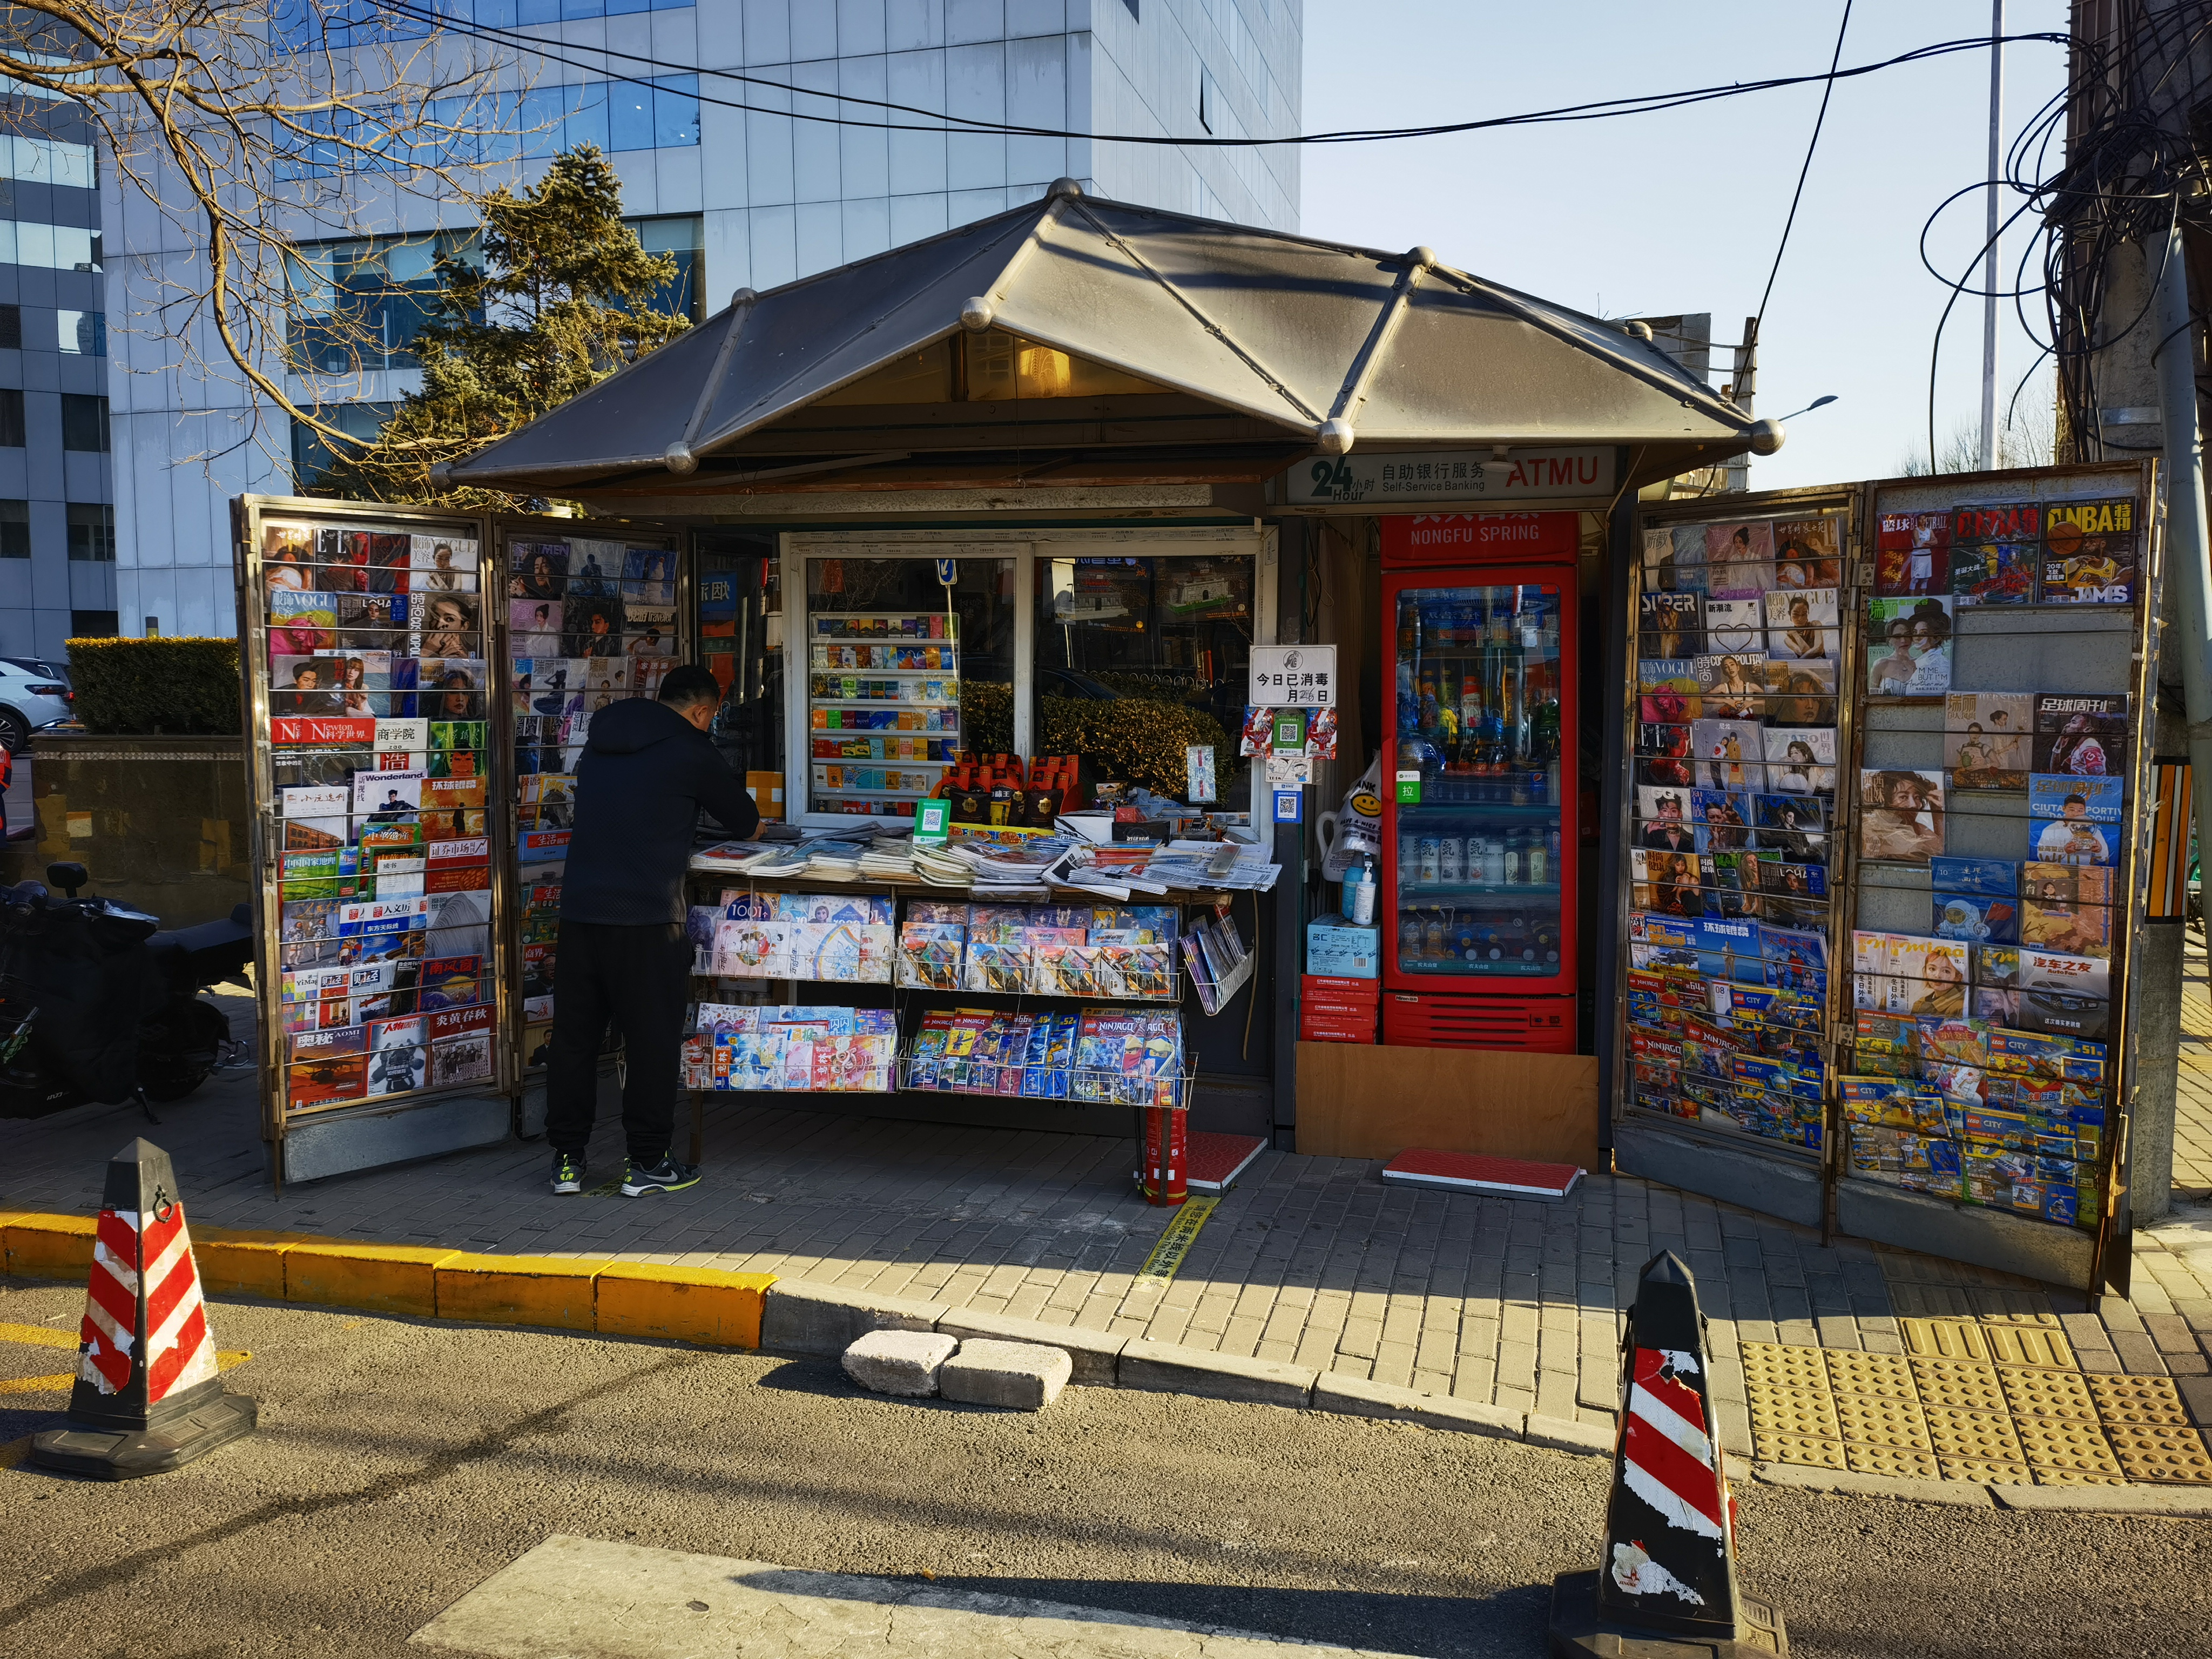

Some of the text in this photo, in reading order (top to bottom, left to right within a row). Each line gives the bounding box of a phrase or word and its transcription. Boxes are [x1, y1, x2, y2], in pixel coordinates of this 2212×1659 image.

[1311, 456, 1352, 496] 24
[1382, 462, 1485, 480] 自助银行服务
[1506, 456, 1597, 487] ATMU
[1352, 478, 1374, 492] 小时
[1382, 481, 1485, 493] Self-Service Banking
[1332, 489, 1364, 501] Hour
[2066, 504, 2114, 533] NBA
[2114, 503, 2132, 531] 特刊
[1883, 516, 1947, 532] 篮球 BAETBALL
[1411, 524, 1540, 545] NONGFU SPRING
[1954, 564, 1980, 576] 圣诞大战
[2070, 585, 2129, 603] JAMES
[294, 594, 337, 608] VOGU
[410, 593, 426, 617] 時尚
[1708, 604, 1733, 613] 新潮流
[1696, 656, 1712, 682] 時尚
[1257, 673, 1328, 686] 今日已消毒
[1918, 673, 1933, 682] BUT
[2040, 698, 2108, 712] 足球周刊
[311, 723, 353, 740] Newton
[1718, 722, 1731, 730] 尼龙
[326, 730, 366, 740] 科学世界
[377, 727, 415, 741] 商学院
[383, 753, 407, 772] 造
[365, 772, 425, 782] Wonderland.
[431, 779, 477, 791] 环球银幕
[1402, 786, 1414, 797] 拉
[1652, 787, 1675, 800] GQ
[537, 834, 557, 846] 生活
[432, 844, 469, 856] 证券市场
[284, 856, 336, 868] 中国国家地理
[367, 922, 399, 932] 东方天际线
[1703, 921, 1750, 937] 环球银幕
[525, 948, 543, 959] 商界
[429, 958, 474, 975] 南风窗
[2033, 956, 2093, 973] 汽车之友
[321, 975, 342, 986] 财经
[353, 970, 380, 987] 财经
[1636, 979, 1660, 988] NINJAGO
[1715, 986, 1725, 995] 08
[1890, 978, 1898, 1008] 冬日外套
[1746, 996, 1761, 1004] CITY
[436, 1008, 488, 1027] 炎黄春秋
[830, 1015, 851, 1029] 闪闪
[962, 1017, 986, 1026] NINJAGO
[334, 1029, 360, 1038] AOMI
[382, 1020, 420, 1035] 人物周刊
[1098, 1022, 1136, 1033] NINJAGO
[296, 1031, 334, 1048] 奥秘
[1702, 1031, 1739, 1053] NINJAGO
[1992, 1038, 2028, 1050] LEGO CITY
[1647, 1040, 1682, 1055] NINJAGO
[717, 1051, 728, 1073] 意林
[1748, 1065, 1763, 1074] CITY
[1860, 1087, 1877, 1095] CITY
[1966, 1118, 2002, 1129] LEGO CITY
[1164, 1225, 1180, 1241] Outside
[1154, 1250, 1166, 1259] Two
